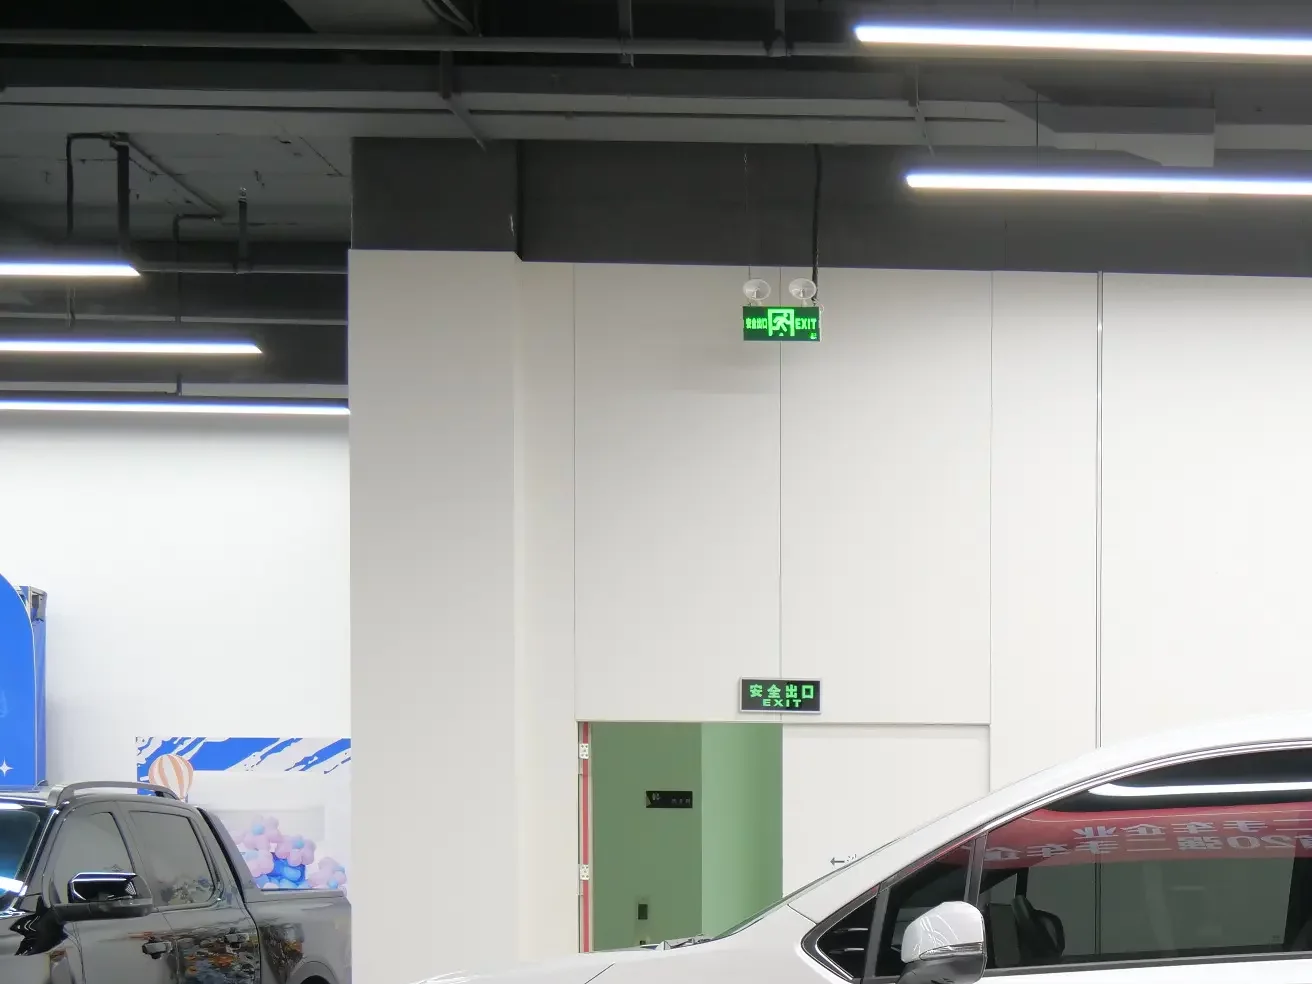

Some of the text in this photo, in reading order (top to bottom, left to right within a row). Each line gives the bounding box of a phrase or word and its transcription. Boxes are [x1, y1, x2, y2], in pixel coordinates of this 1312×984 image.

[794, 317, 817, 330] EXIT
[749, 683, 814, 699] 安全出口
[762, 698, 802, 708] EXIT
